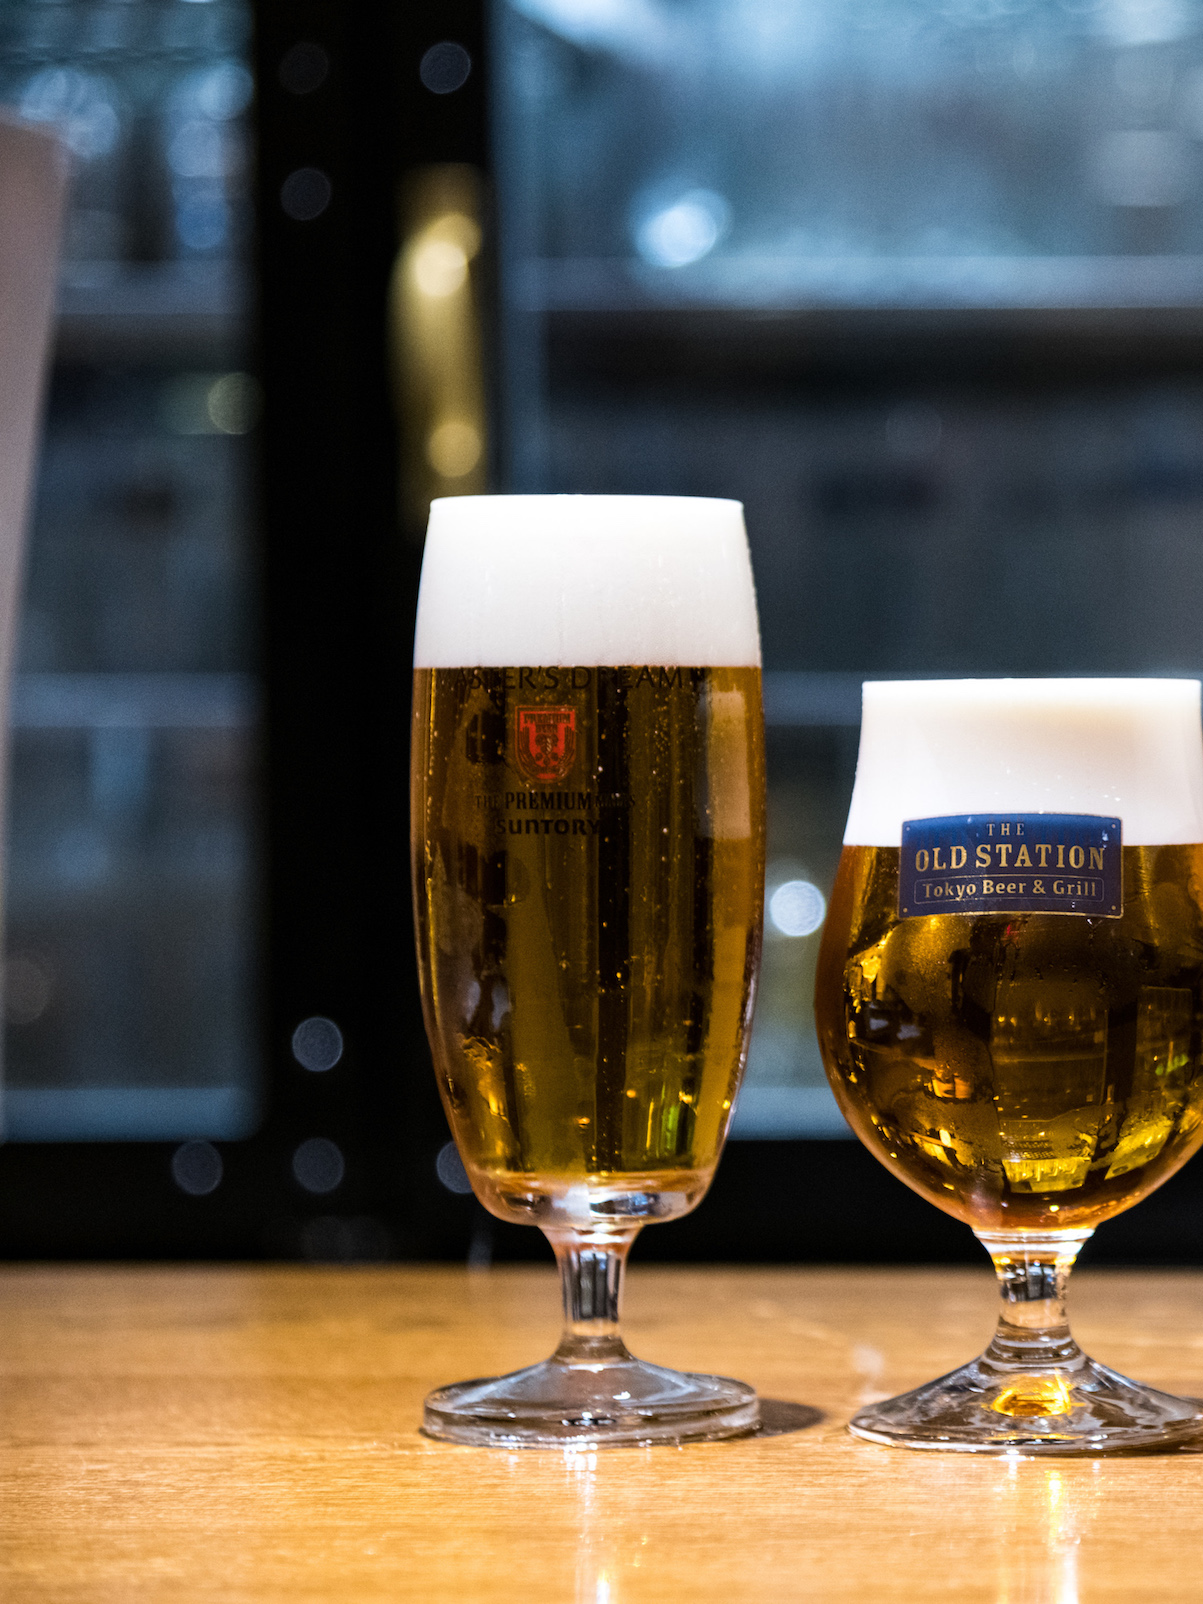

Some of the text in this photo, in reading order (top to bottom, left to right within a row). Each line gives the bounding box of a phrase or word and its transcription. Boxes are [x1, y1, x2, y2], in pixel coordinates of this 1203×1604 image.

[572, 665, 683, 690] DREAM
[504, 792, 592, 809] PREMIUM
[986, 823, 1025, 836] THE
[915, 843, 1104, 872] OLD STATION
[922, 879, 1096, 899] Tokyo Beer & Grill
